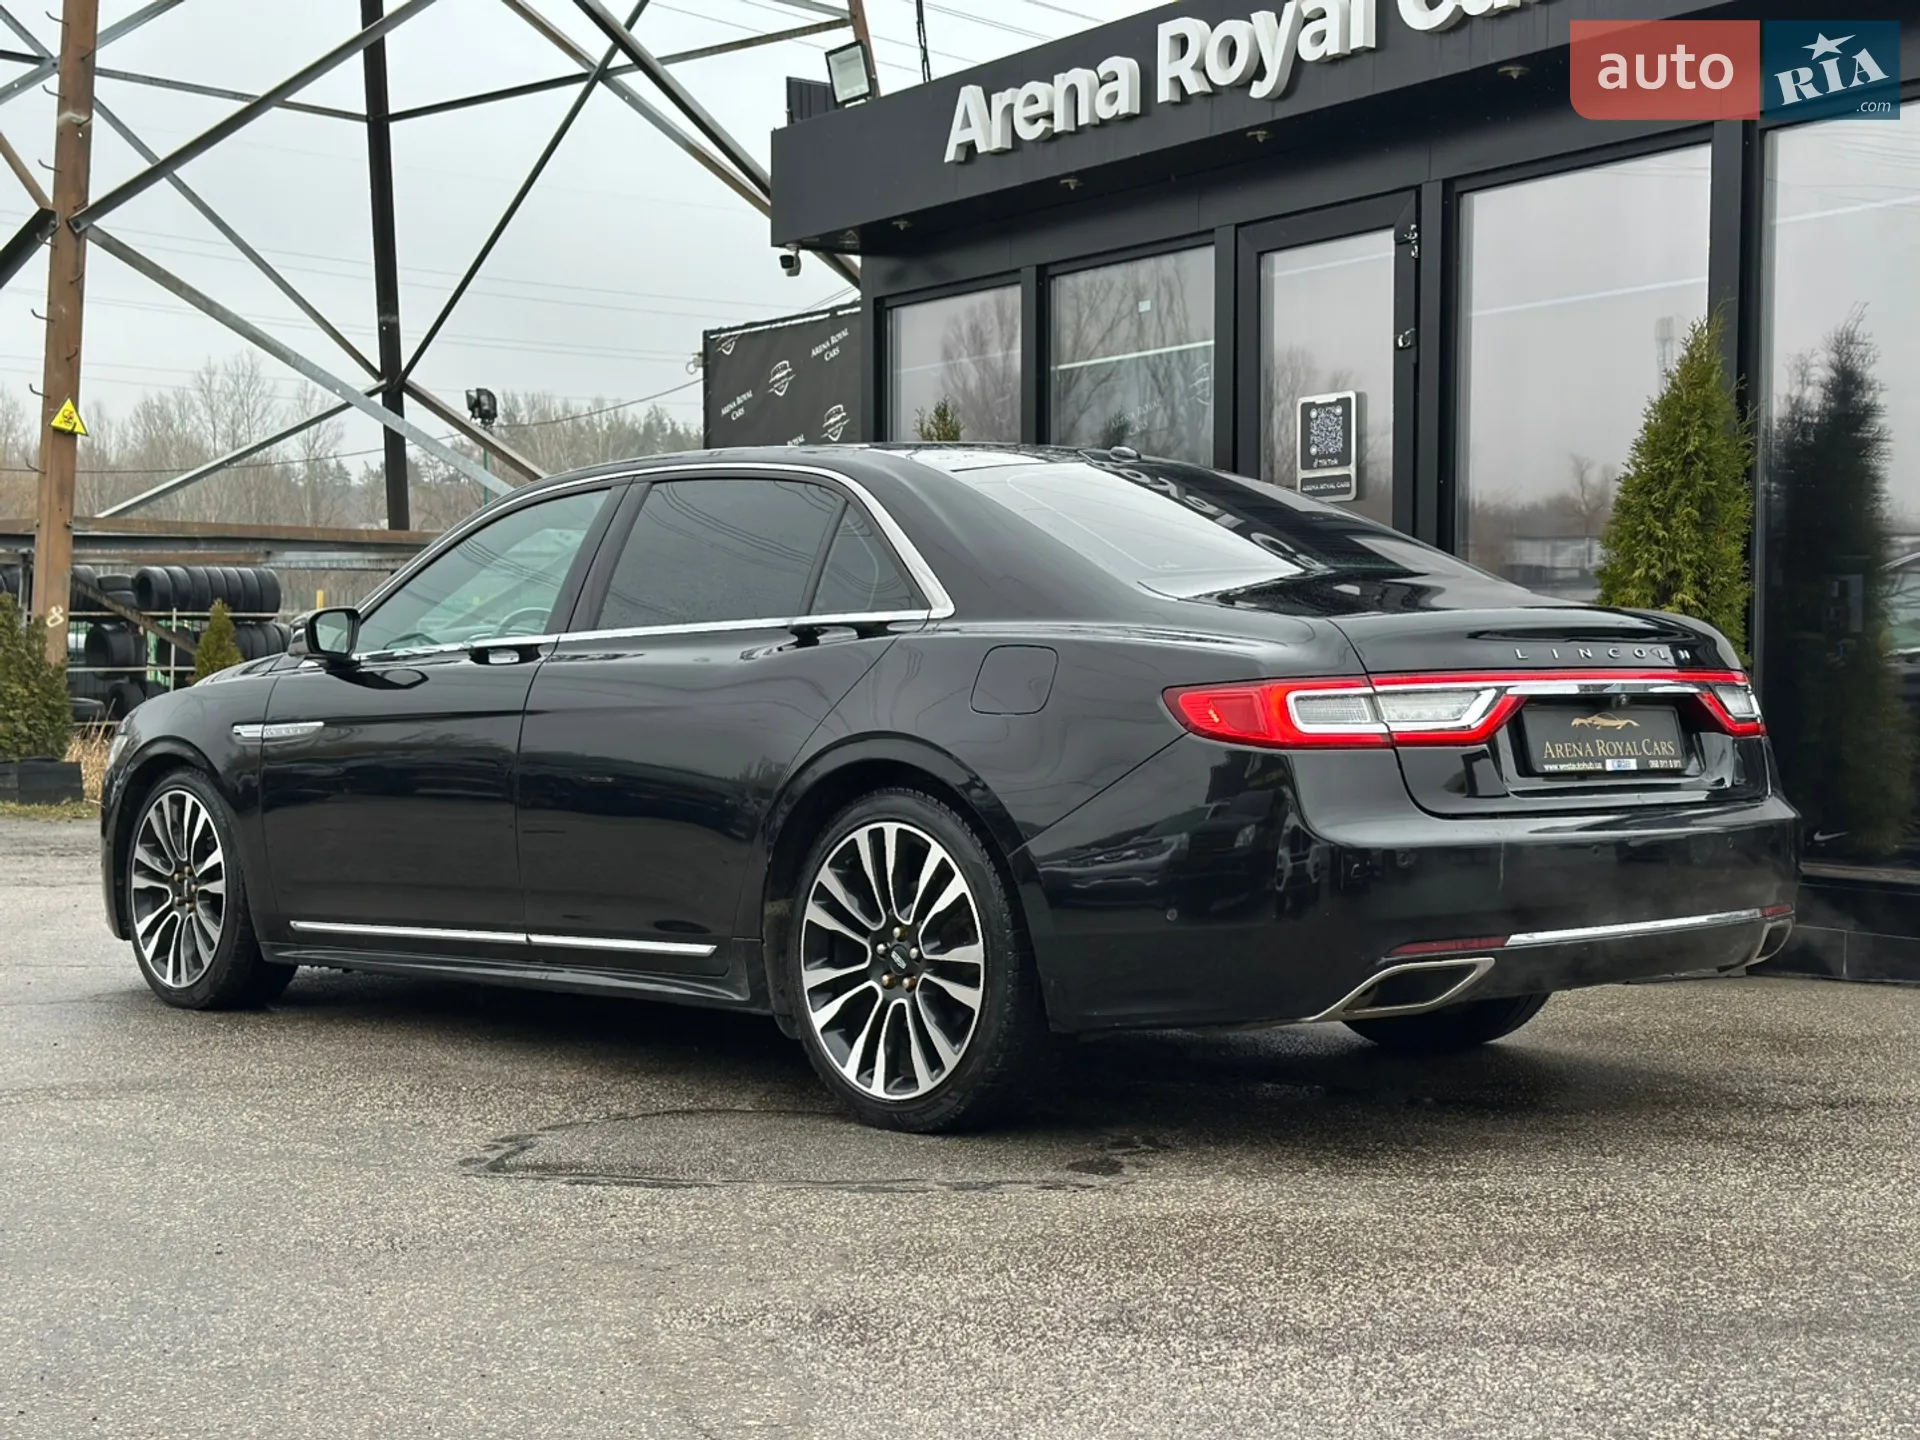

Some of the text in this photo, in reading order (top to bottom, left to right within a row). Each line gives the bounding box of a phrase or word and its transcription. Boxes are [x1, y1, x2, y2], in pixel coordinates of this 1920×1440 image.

[944, 55, 1141, 163] Arena
[1515, 647, 1692, 660] LINCOLN
[1543, 738, 1676, 759] ARENA ROYAL CARS
